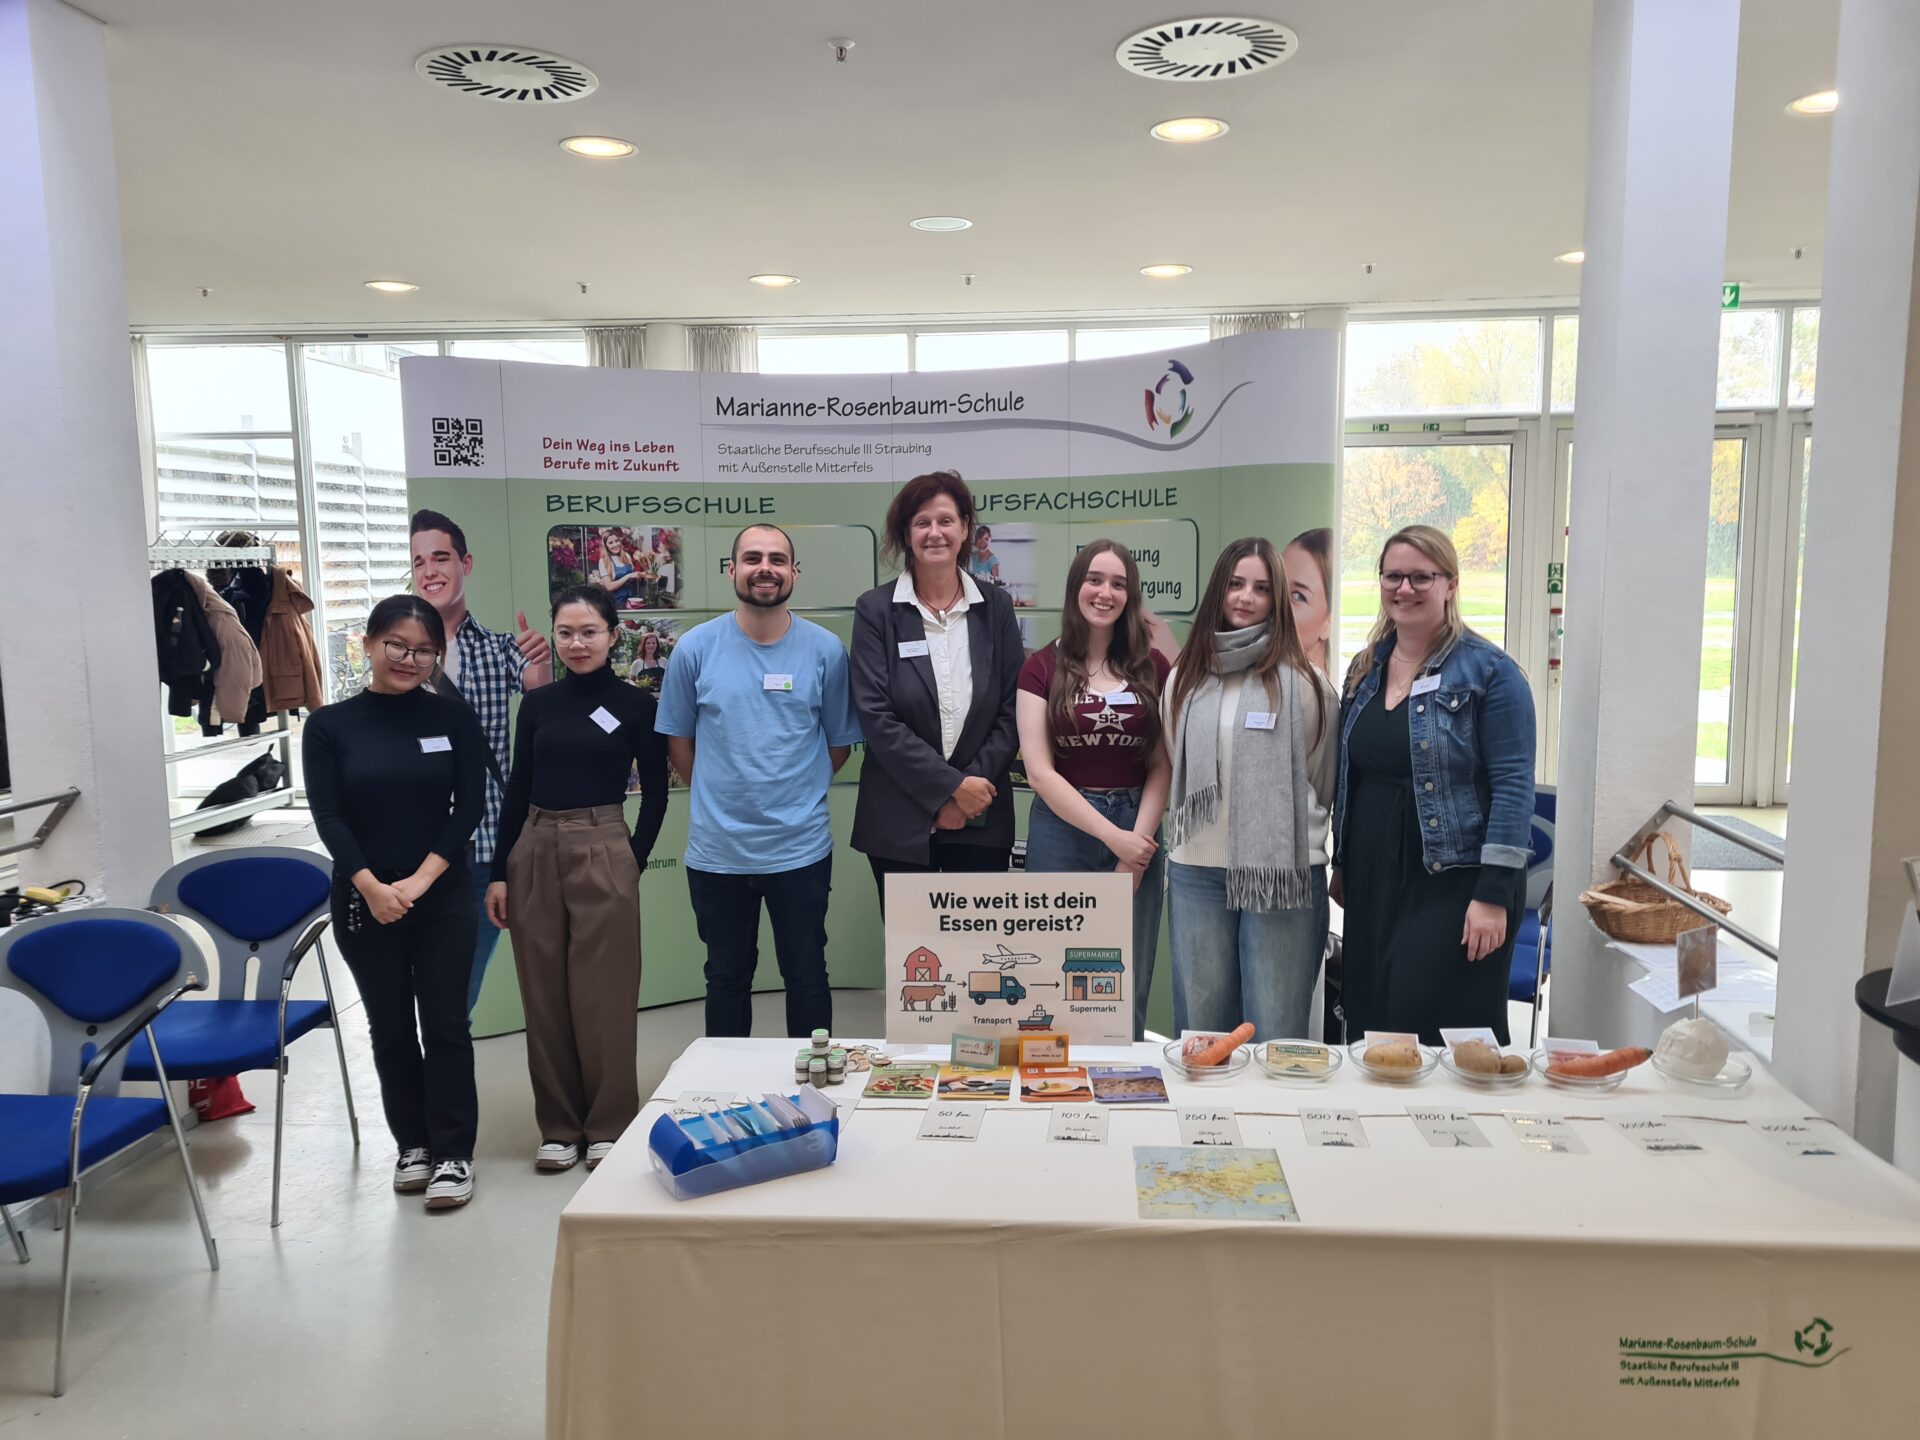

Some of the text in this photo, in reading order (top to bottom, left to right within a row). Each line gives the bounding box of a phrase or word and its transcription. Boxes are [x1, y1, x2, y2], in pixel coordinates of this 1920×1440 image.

[716, 390, 1025, 418] Marianne-Rosenbaum-Schule
[543, 437, 674, 454] Dein Weg ins Leben
[718, 444, 781, 455] Staatliche
[784, 444, 860, 455] Berufsschule
[875, 443, 931, 456] Straubing
[544, 457, 679, 471] Berufe mit Zukunft
[719, 461, 873, 473] mit Außenstelle Mitterfels
[547, 495, 775, 514] BERUFSSCHULE
[973, 487, 1178, 512] UFSFACHSCHULE
[1140, 580, 1182, 600] rgung
[1098, 713, 1120, 724] 92
[1105, 733, 1147, 747] YOR
[647, 858, 677, 870] ntrum
[929, 892, 1096, 909] Wie weit ist dein
[940, 914, 1084, 936] Essen gereist?
[1069, 951, 1119, 959] SUPERMARKET
[1070, 1005, 1116, 1014] Supermarkt
[918, 1015, 934, 1023] Hof
[973, 1016, 1011, 1026] Transport
[1185, 1113, 1207, 1121] 250
[1414, 1113, 1446, 1121] 1000
[1620, 1336, 1757, 1350] Marianne-Rosenbaum-Schule
[1620, 1359, 1739, 1372] Staatliche Berufsschule III
[1620, 1376, 1739, 1388] mit Außenstelle Mitterfels
